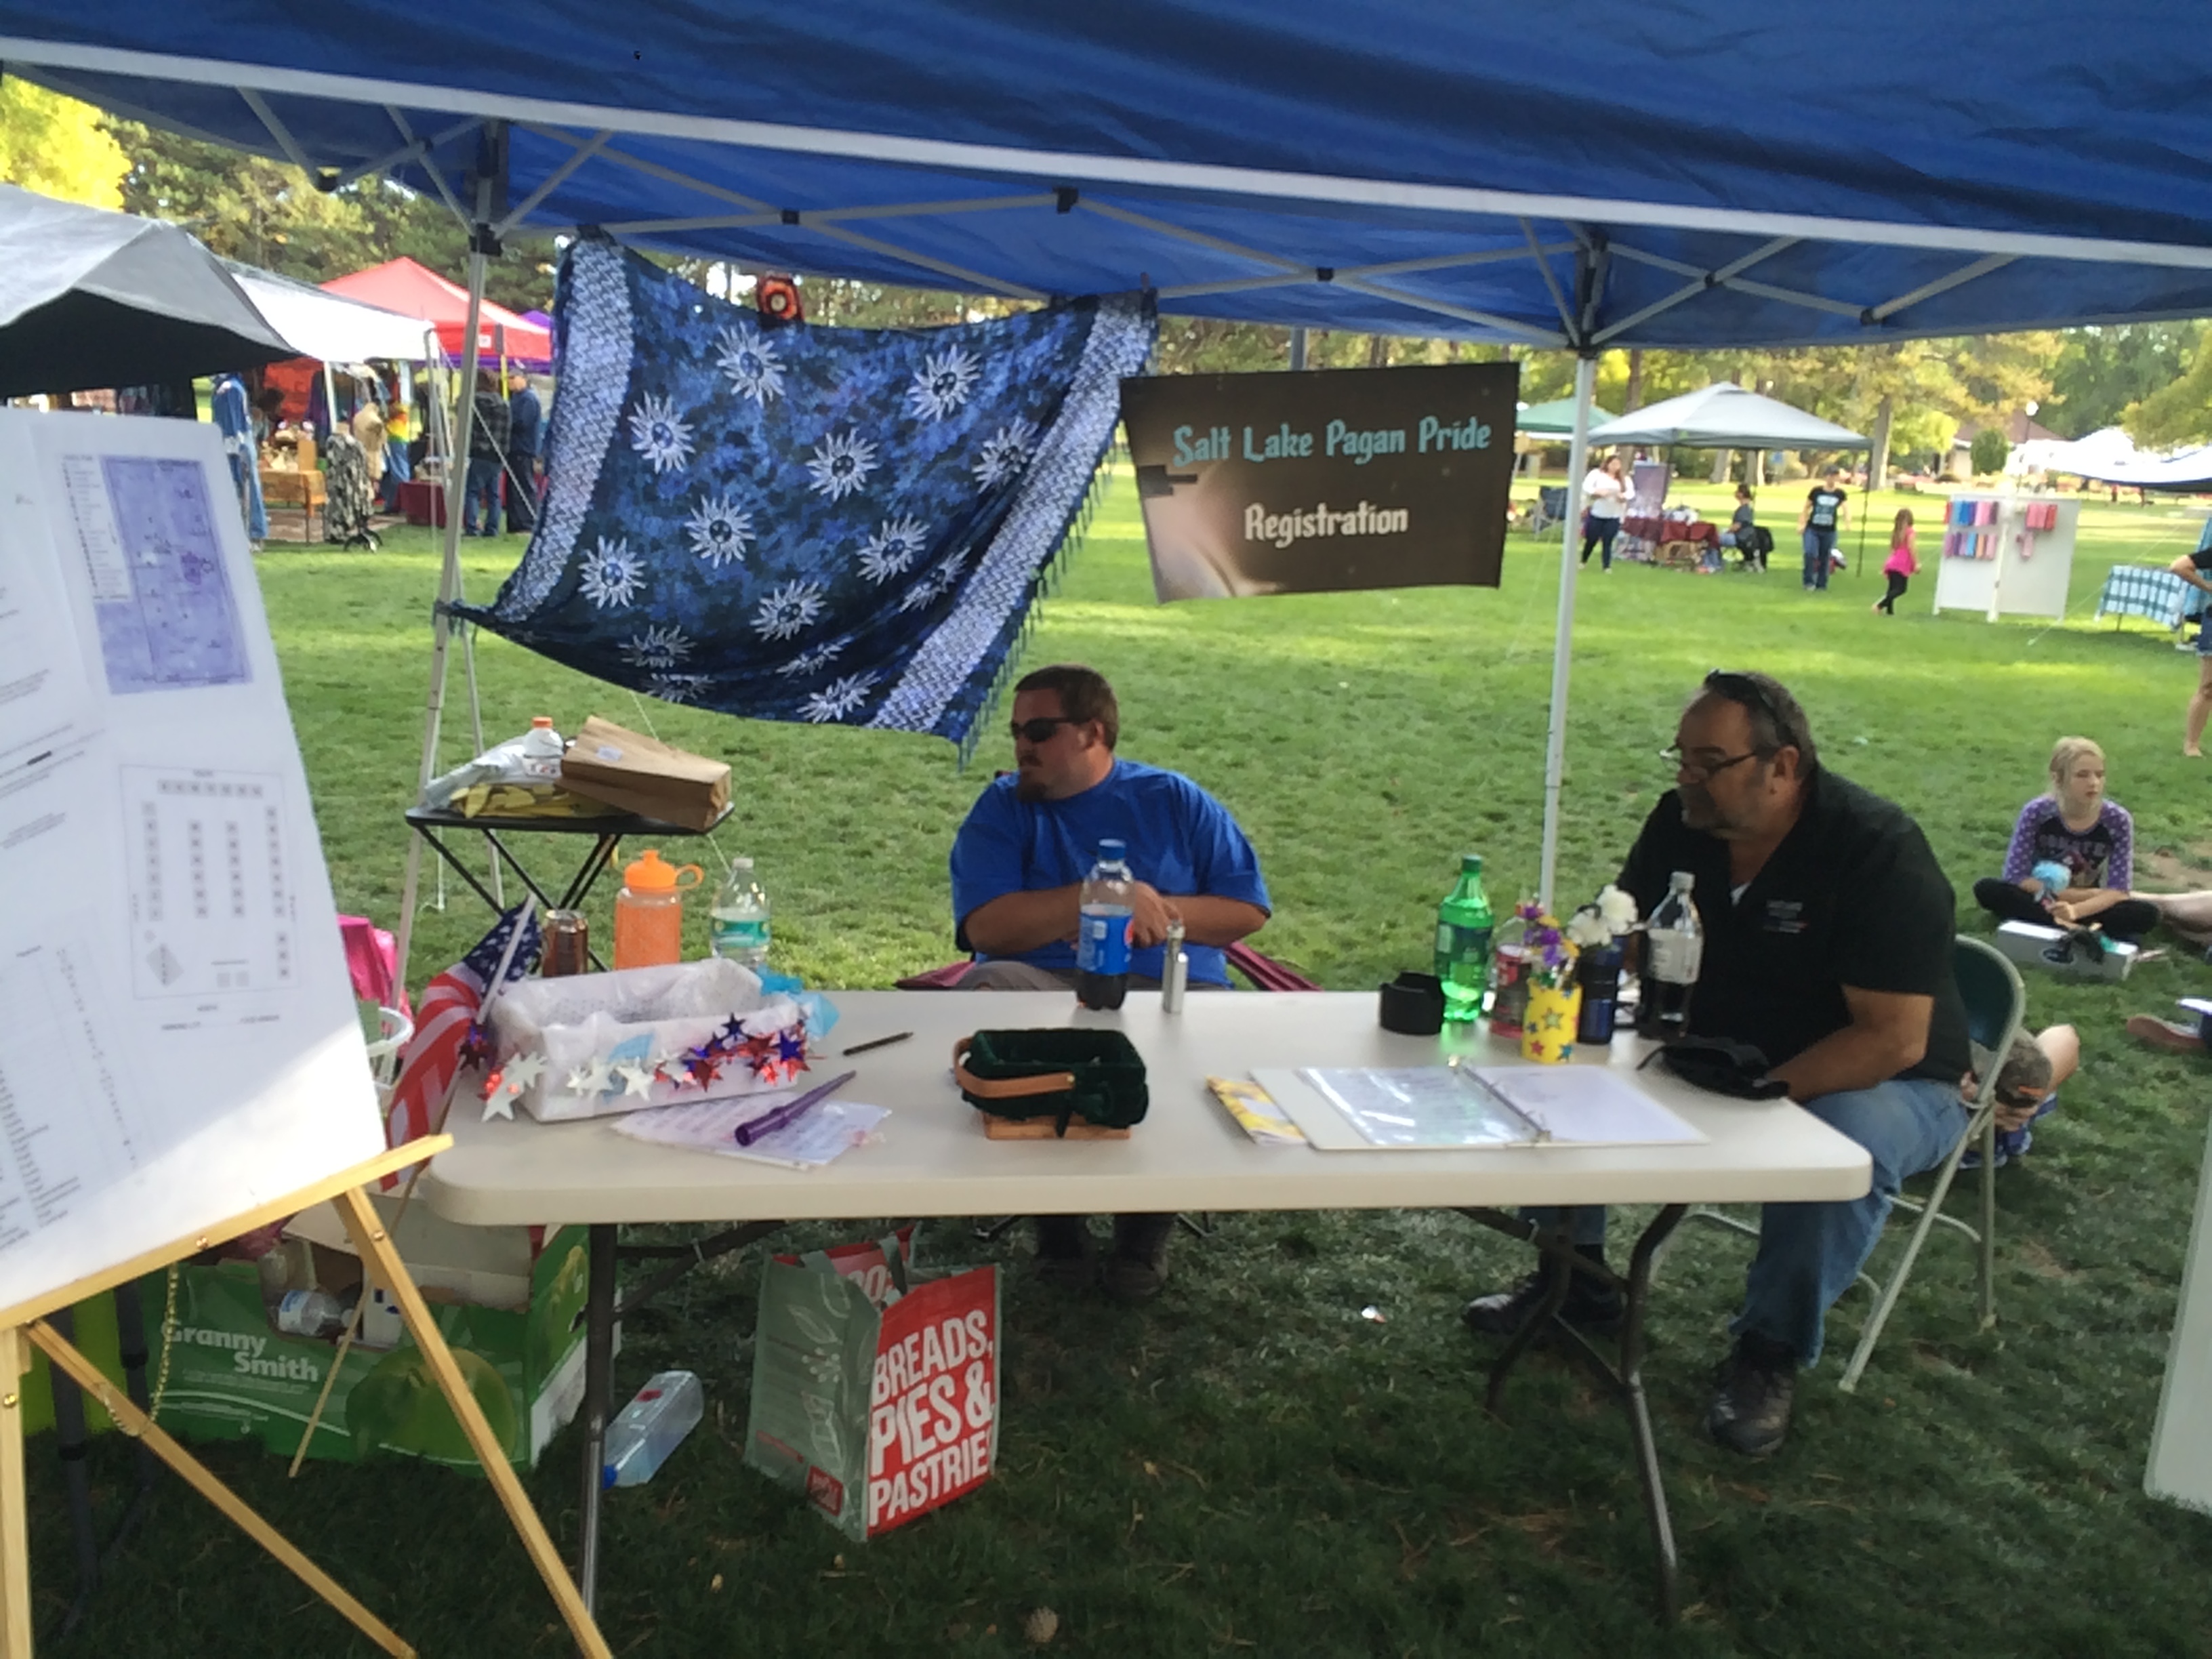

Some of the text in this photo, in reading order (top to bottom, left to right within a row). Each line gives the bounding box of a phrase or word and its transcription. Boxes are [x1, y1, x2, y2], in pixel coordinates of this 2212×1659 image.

[1173, 415, 1491, 468] Salt Lake Pagan Pride
[1244, 500, 1409, 549] Registration
[161, 1319, 268, 1359] Granny
[234, 1351, 319, 1382] Smith
[870, 1359, 996, 1478] PIES &
[868, 1427, 993, 1528] PASTRIE
